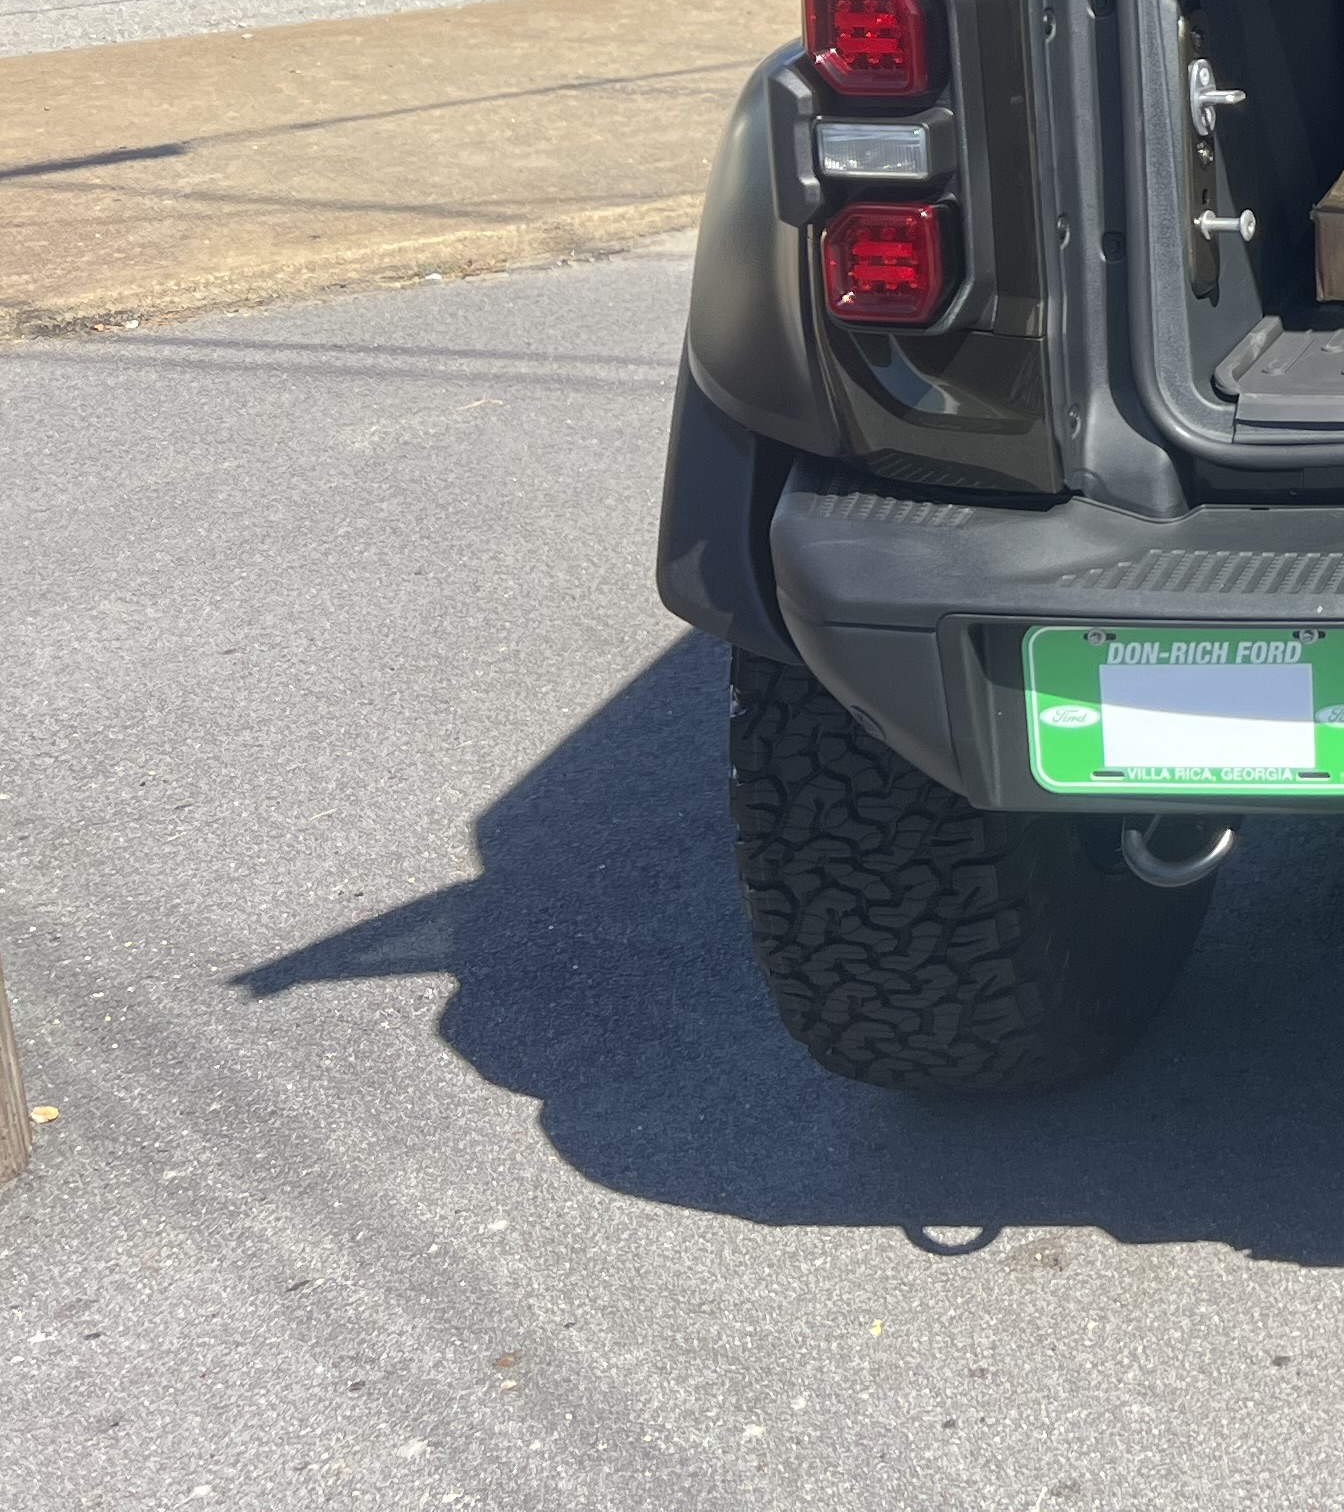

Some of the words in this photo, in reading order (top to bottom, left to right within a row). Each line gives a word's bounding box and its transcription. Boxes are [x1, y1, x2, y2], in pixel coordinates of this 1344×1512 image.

[1106, 641, 1229, 665] DON-RICH
[1235, 640, 1302, 664] FORD
[1127, 767, 1171, 781] VILLA
[1220, 767, 1294, 781] GEORGIA
